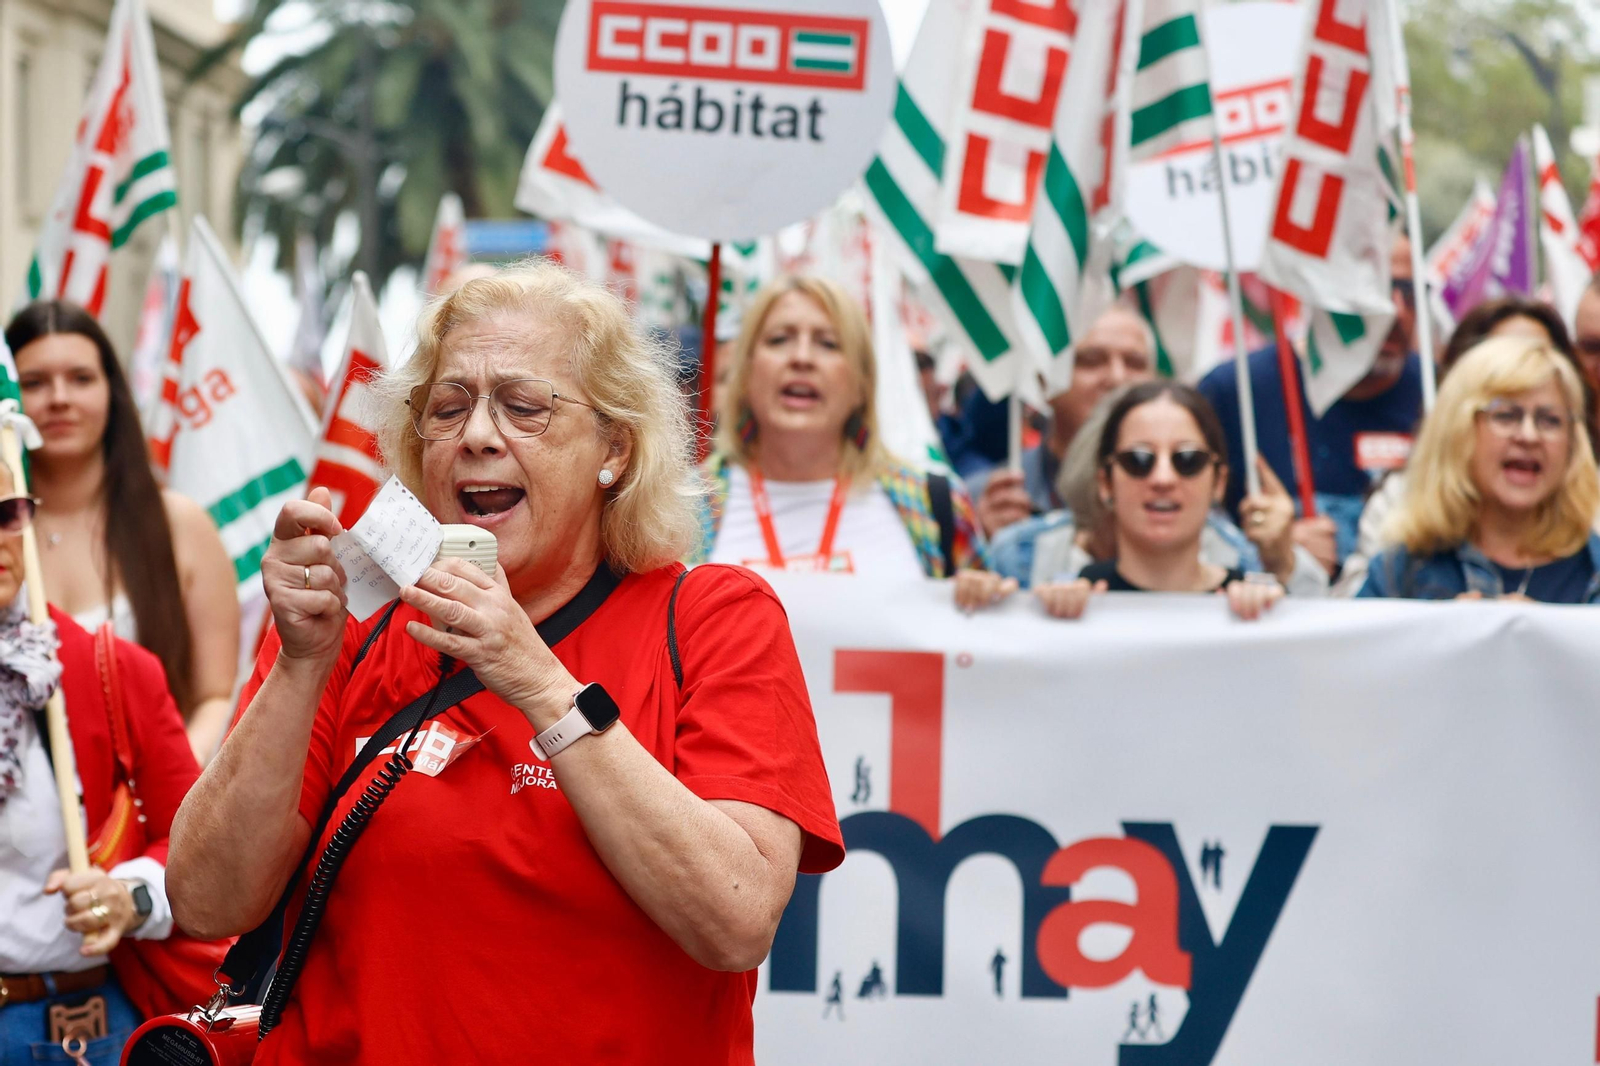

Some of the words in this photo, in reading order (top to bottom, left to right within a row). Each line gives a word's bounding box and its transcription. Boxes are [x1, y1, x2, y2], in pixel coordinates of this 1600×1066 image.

[597, 15, 781, 70] CCOO
[617, 81, 825, 142] hábitat
[1165, 144, 1274, 198] hábi
[769, 811, 1320, 1066] may
